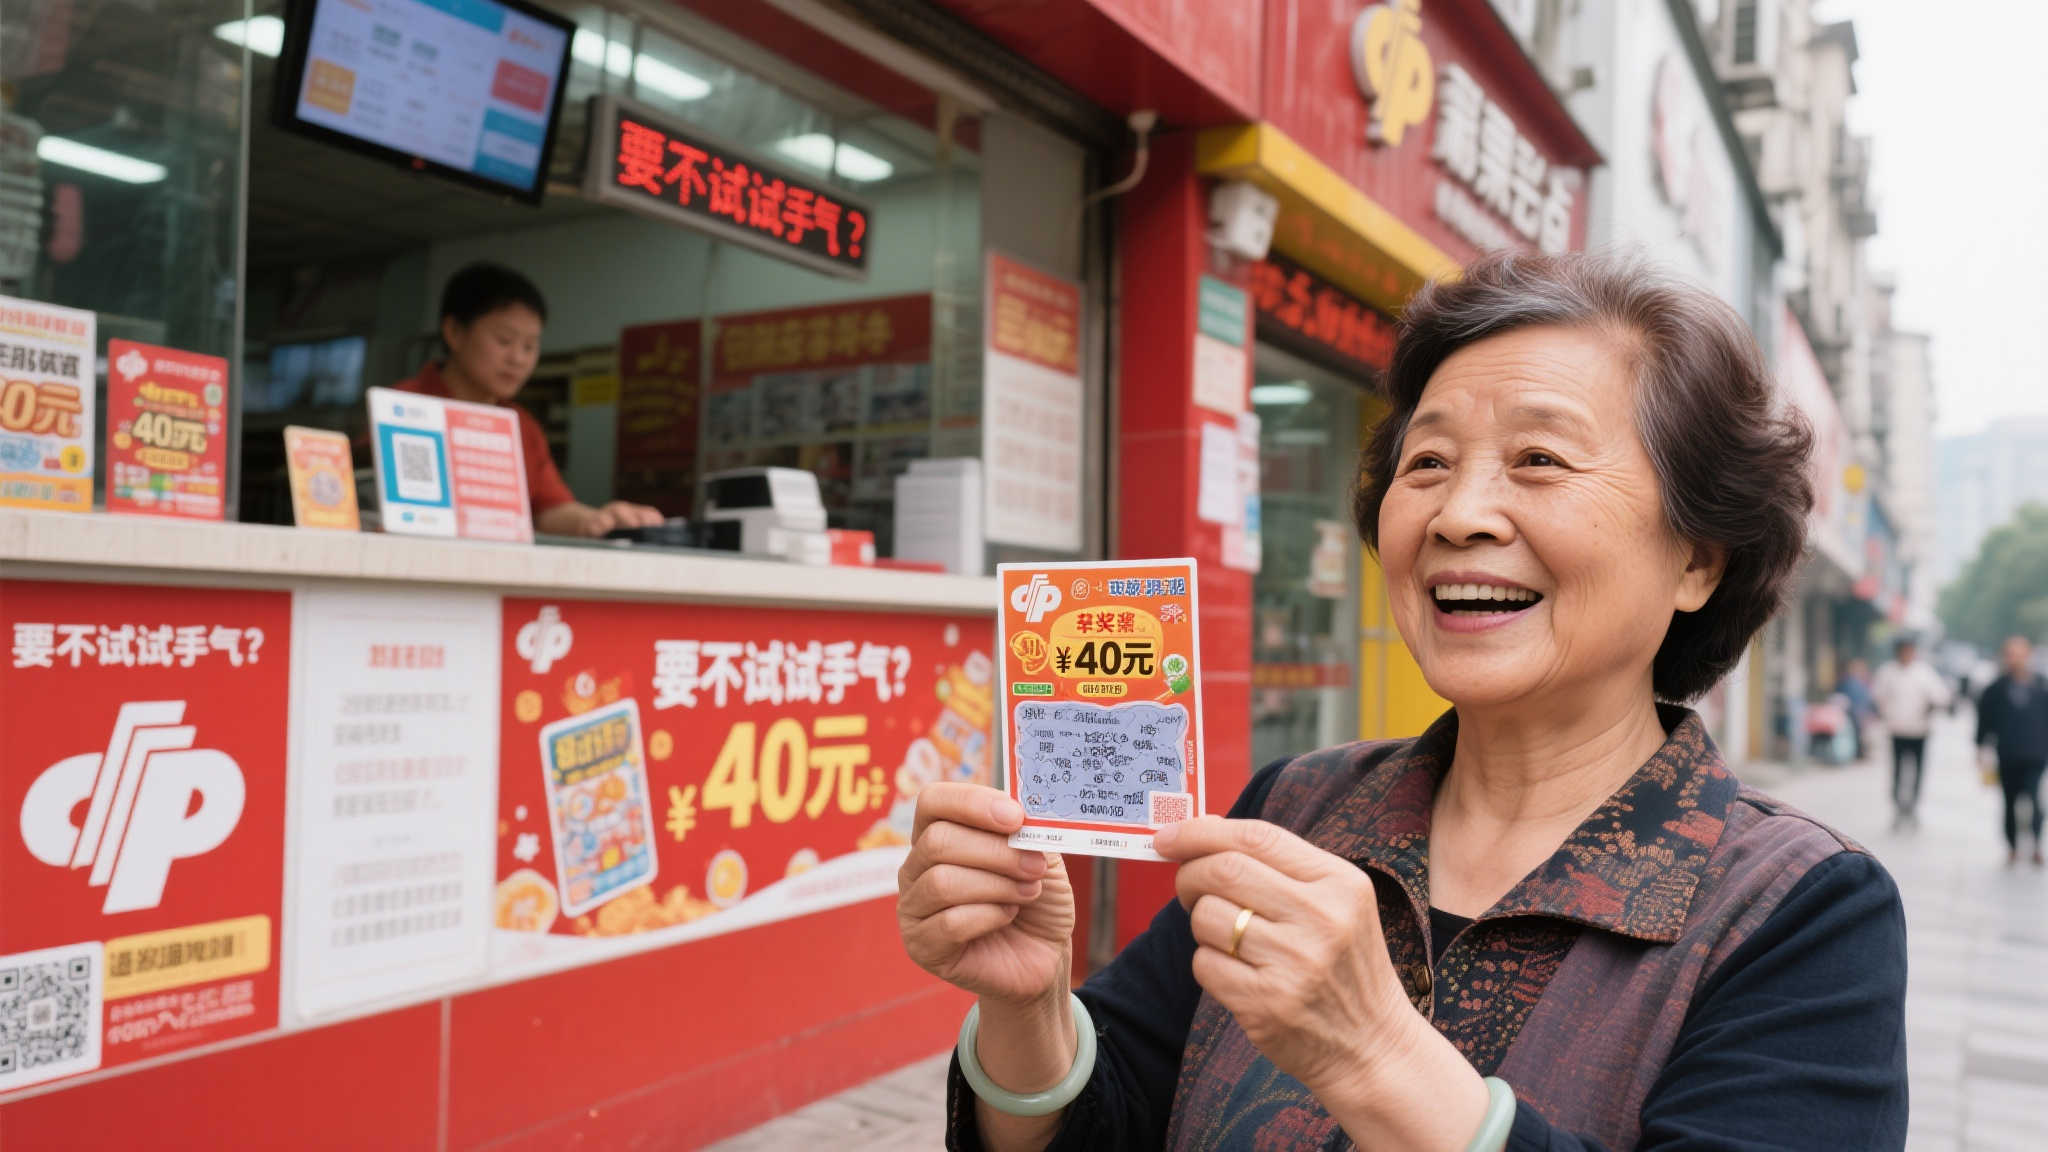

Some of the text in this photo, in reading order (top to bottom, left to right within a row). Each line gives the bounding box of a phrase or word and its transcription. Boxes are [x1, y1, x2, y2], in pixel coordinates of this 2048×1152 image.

[618, 120, 866, 259] 要不试试手气?
[0, 379, 83, 438] 0元
[132, 411, 208, 454] 40元
[12, 622, 265, 669] 要不试试手气?
[1056, 641, 1154, 676] ¥40元
[652, 639, 912, 710] 要不试试手气?
